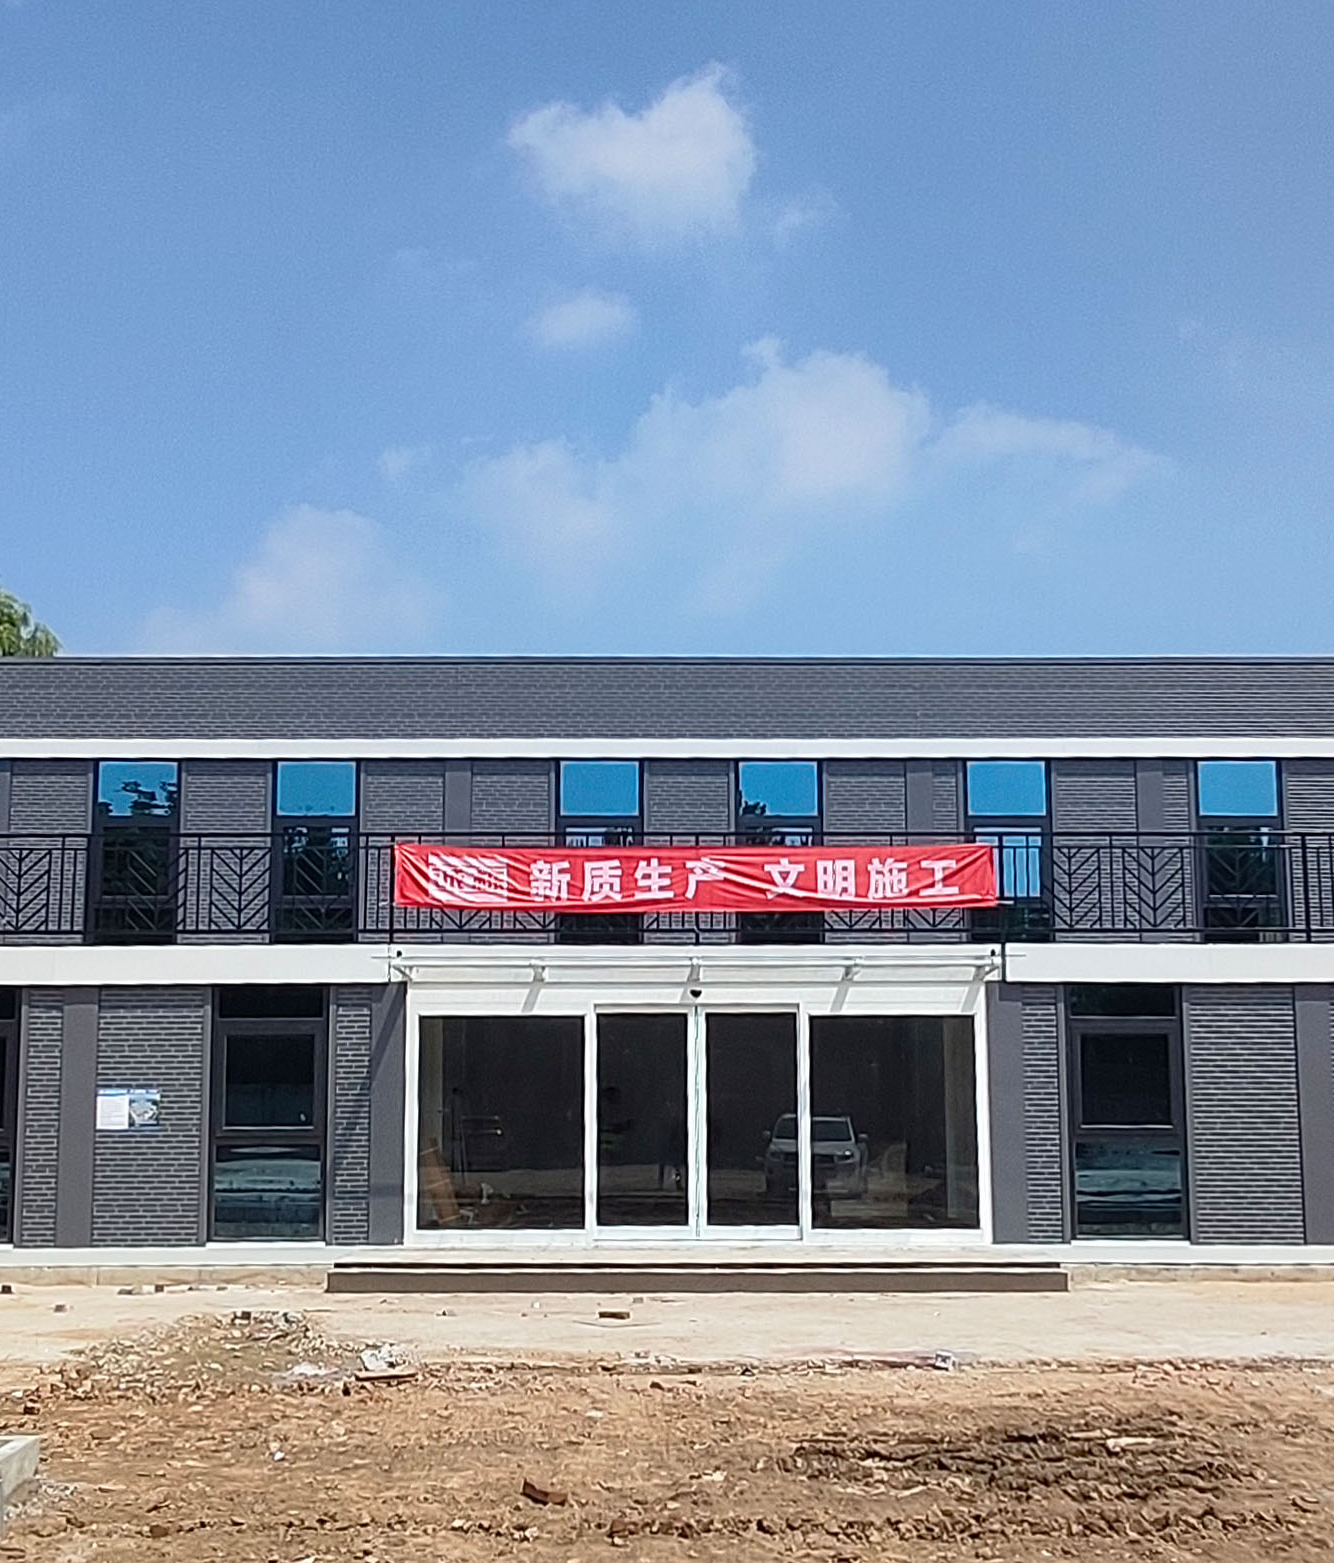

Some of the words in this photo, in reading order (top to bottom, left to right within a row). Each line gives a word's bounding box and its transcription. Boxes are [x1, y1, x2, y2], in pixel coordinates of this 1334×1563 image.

[530, 857, 726, 902] 新质生产
[764, 858, 959, 900] 文明施工
